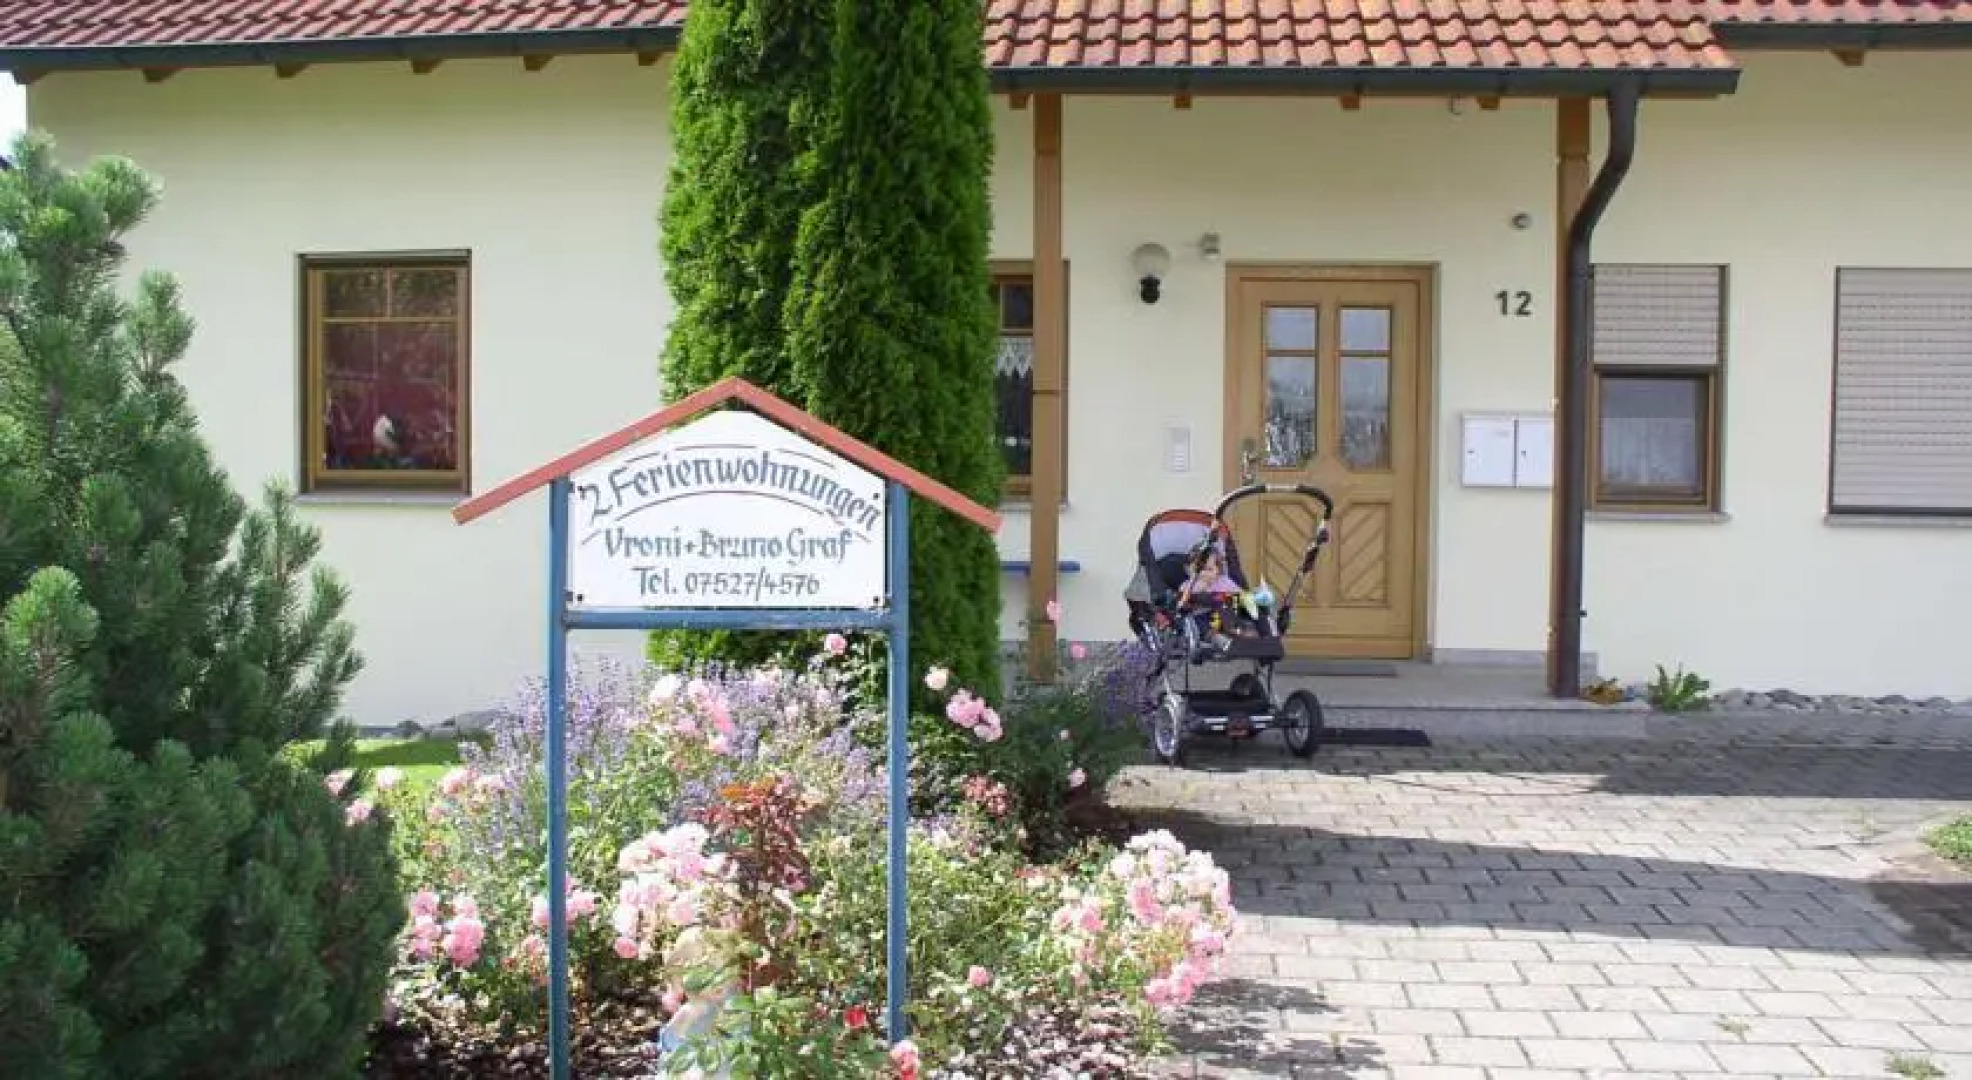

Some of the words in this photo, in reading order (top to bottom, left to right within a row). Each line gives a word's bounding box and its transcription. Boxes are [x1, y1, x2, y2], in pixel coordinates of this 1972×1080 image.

[1495, 290, 1532, 316] 12
[577, 484, 613, 525] 2
[608, 451, 881, 531] Ferienwohnungen
[786, 528, 852, 565] Graf
[631, 566, 677, 596] Tel.
[684, 566, 820, 601] 07527/4576
